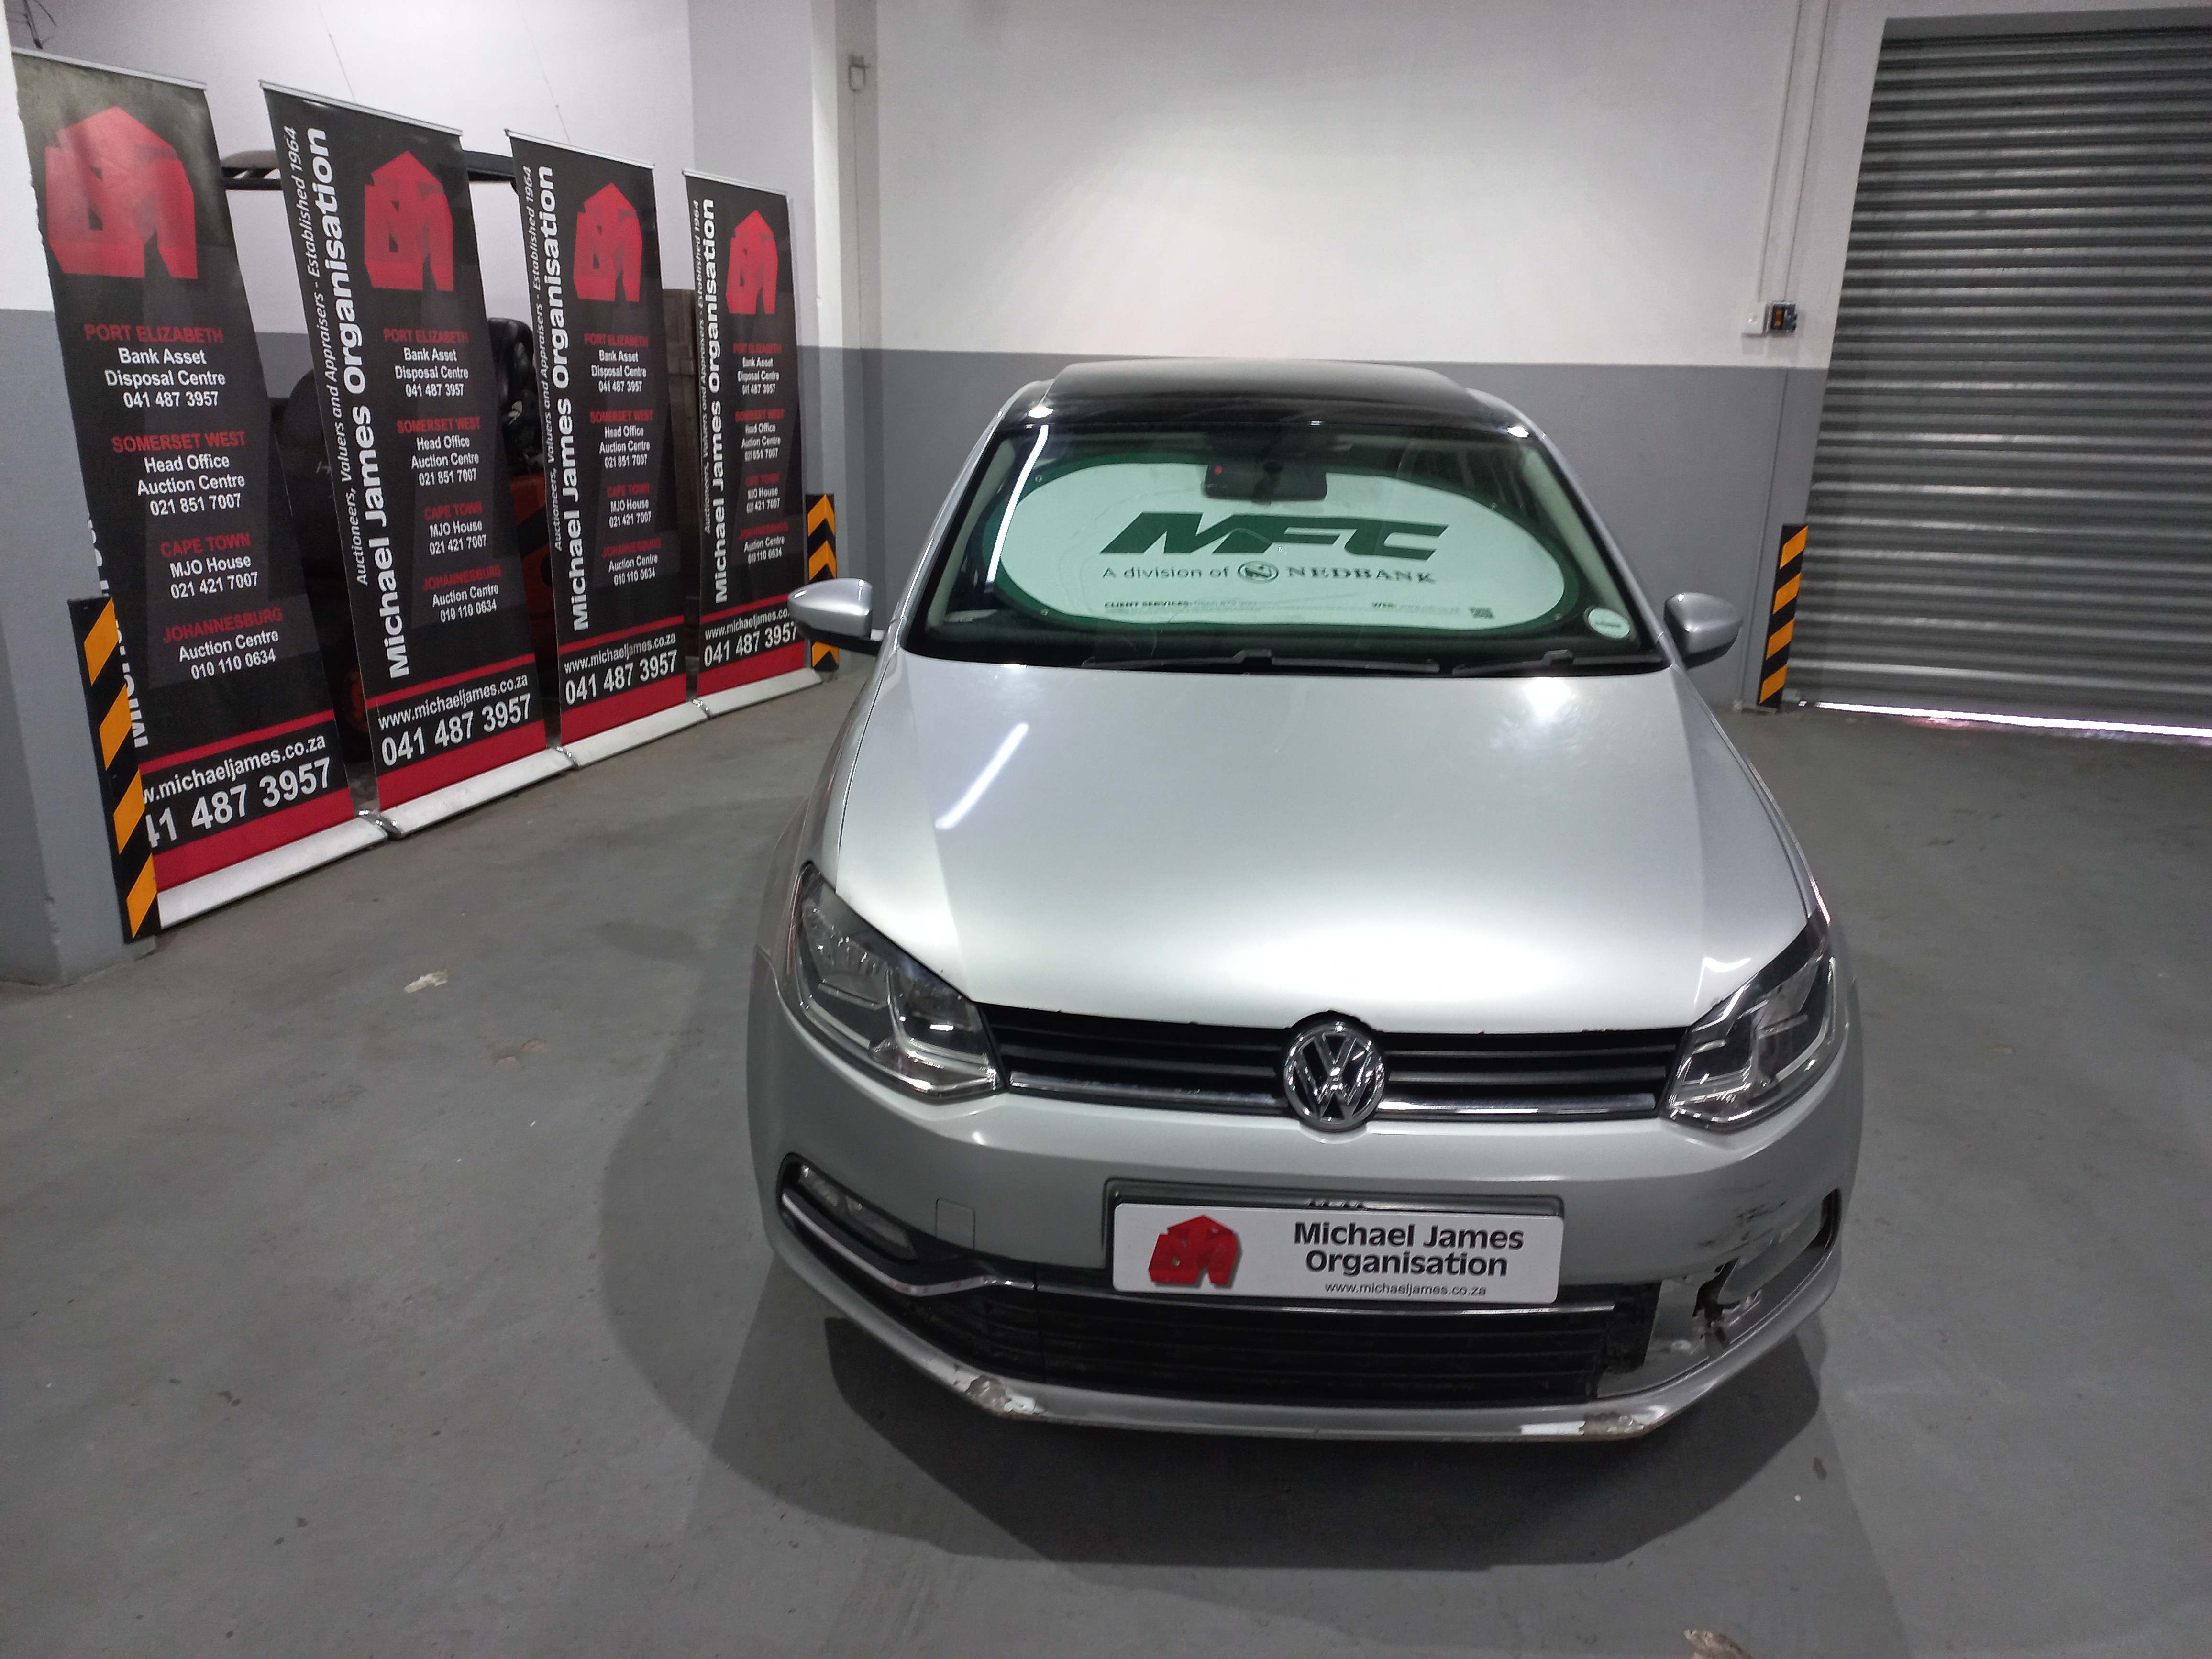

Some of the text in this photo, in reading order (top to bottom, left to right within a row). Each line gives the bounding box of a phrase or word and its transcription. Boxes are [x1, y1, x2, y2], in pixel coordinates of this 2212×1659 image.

[523, 165, 535, 203] 1964
[526, 205, 542, 291] Established
[703, 199, 720, 393] Organisation
[84, 324, 224, 343] PORT ELIZABETH
[118, 347, 207, 365] Bank Asset
[284, 125, 368, 586] Auctioneers, Valuers and Appraisers Established 1964
[404, 347, 457, 362] Bank Asset
[104, 369, 226, 389] Disposal Centre
[394, 365, 469, 381] Disposal Centre
[624, 366, 647, 377] Centre
[123, 391, 219, 408] 041 487 3957
[405, 383, 464, 398] 041 487 3957
[538, 166, 589, 631] Michael James Organisation
[307, 127, 409, 678] Michael James Organisation
[111, 431, 245, 453] SOMERSET WEST
[623, 425, 644, 437] Office
[416, 435, 470, 451] Head Office
[599, 440, 650, 454] Auction Centre
[711, 400, 724, 492] James
[144, 454, 230, 473] Head Office
[411, 452, 479, 470] Auction Centre
[604, 454, 648, 469] 021 851 7007
[138, 474, 245, 496] Auction Centre
[419, 468, 477, 486] 021 851 7007
[150, 493, 241, 516] 021 851 7007
[610, 498, 649, 513] MJO House
[430, 520, 482, 538] MJO House
[609, 511, 652, 529] 021 421 7007
[160, 533, 251, 557] CAPE TOWN
[429, 534, 487, 556] 021 421 7007
[1100, 512, 1448, 561] MFC
[713, 498, 727, 603] Michael
[169, 555, 251, 578] MJO House
[627, 571, 638, 583] 110
[1102, 566, 1436, 584] A division of NEDBANK
[170, 571, 258, 599] 021 421 7007
[432, 583, 499, 608] Auction Centre
[440, 598, 497, 623] 010 110 0634
[163, 607, 283, 643] JOHANNESBURG
[705, 608, 790, 641] www.michaeljames.co.
[179, 630, 278, 662] Auction Centre
[564, 632, 676, 674] www.michaeljames.co.za
[704, 640, 730, 667] 041
[735, 630, 760, 657] 487
[191, 648, 276, 680] 010 110 0634
[565, 650, 678, 706] 041 487 3957
[378, 673, 528, 730] www.michaeljames.co.za
[381, 693, 531, 766] 041 487 3957
[144, 735, 326, 804] w.michaeljames.co.za
[191, 784, 247, 830] 487
[259, 757, 330, 807] 3957
[1294, 1221, 1525, 1250] Michael James
[1306, 1250, 1508, 1277] Organisation
[1325, 1283, 1486, 1296] www.michaeljames.co.za
